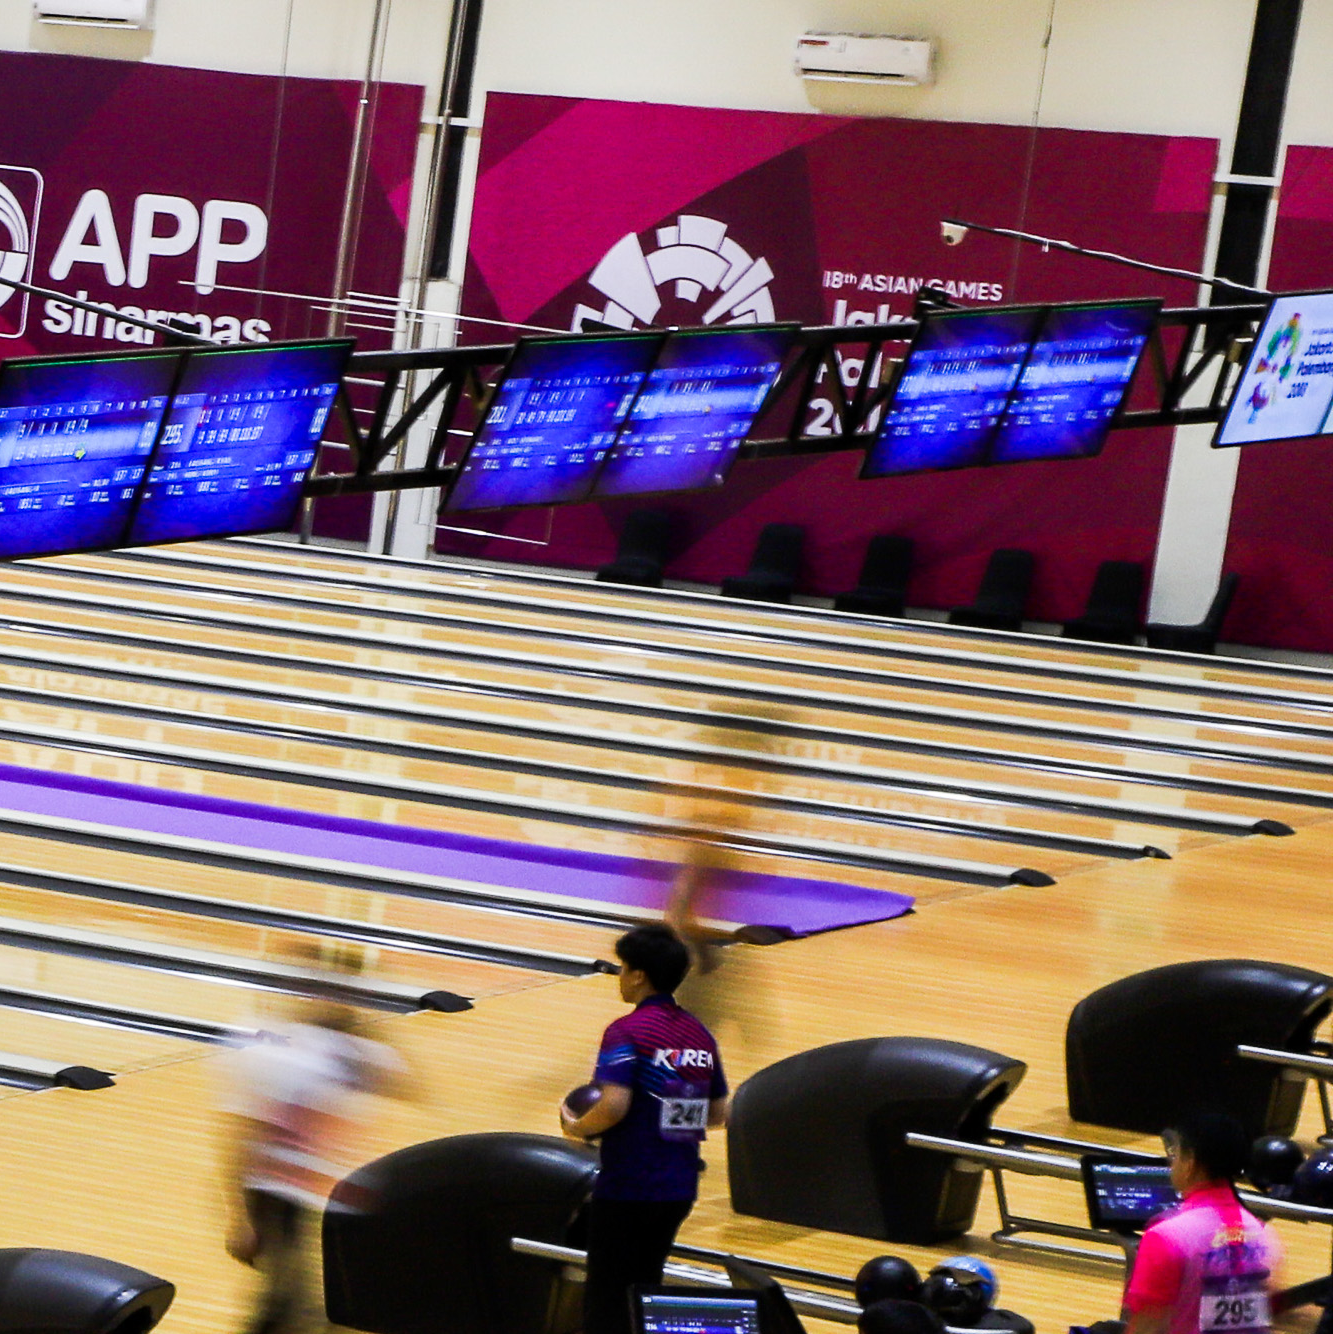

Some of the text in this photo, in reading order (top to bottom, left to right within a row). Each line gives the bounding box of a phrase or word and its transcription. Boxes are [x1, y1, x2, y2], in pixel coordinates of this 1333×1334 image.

[48, 188, 268, 295] APP
[857, 273, 924, 295] ASIAN
[1213, 1299, 1257, 1326] 295
